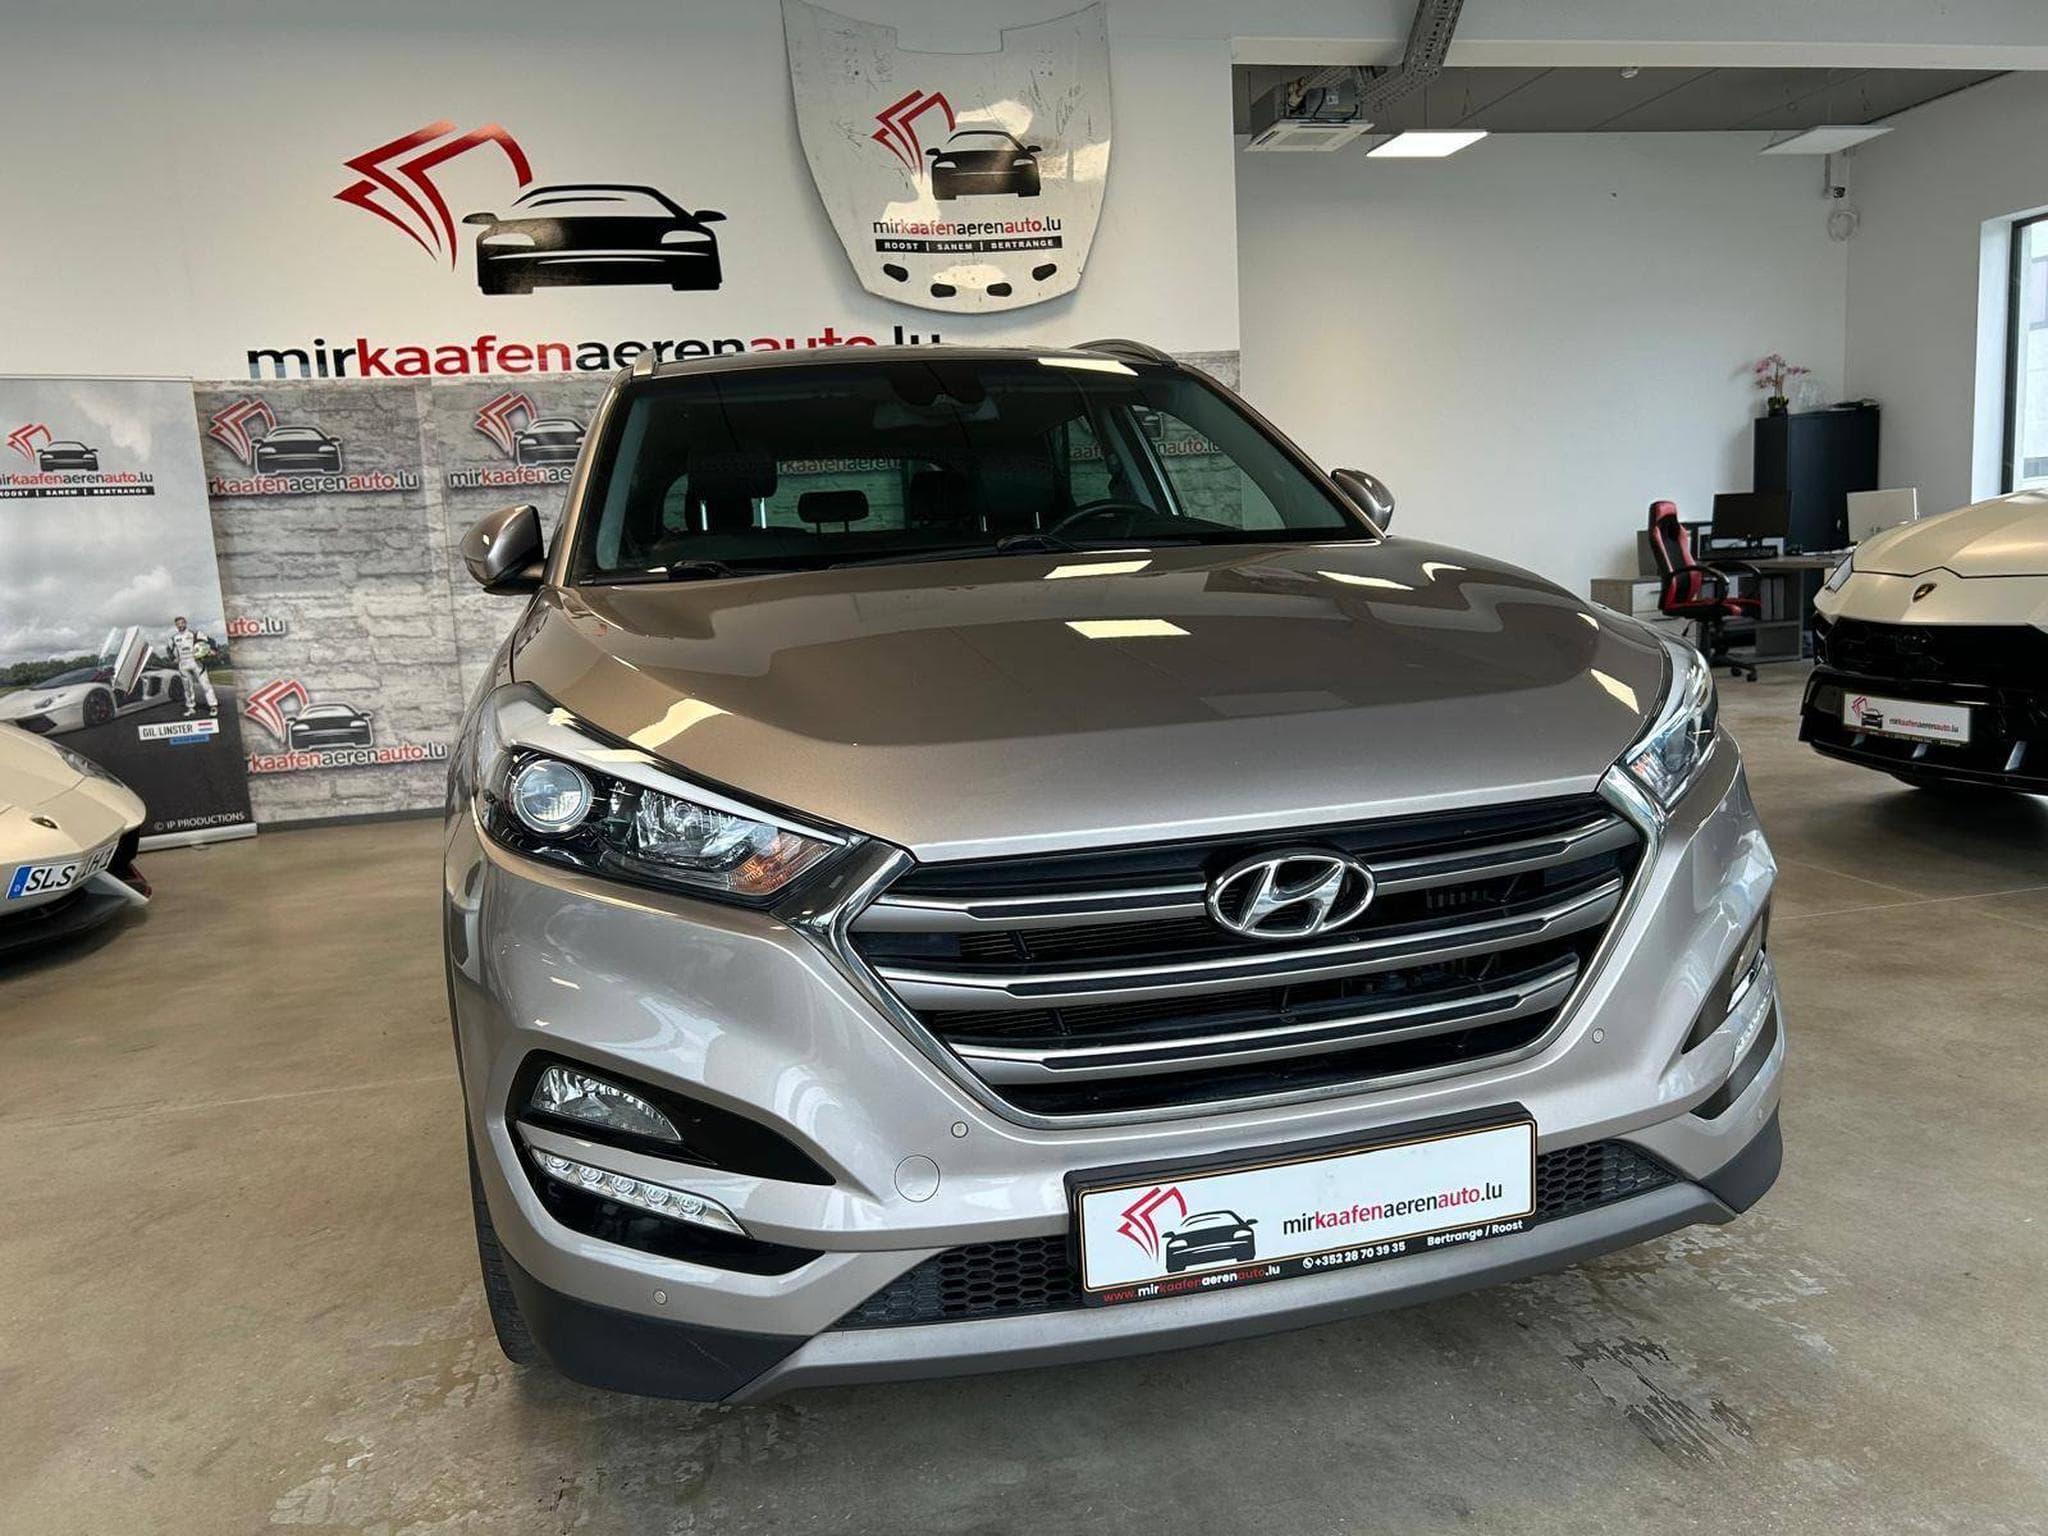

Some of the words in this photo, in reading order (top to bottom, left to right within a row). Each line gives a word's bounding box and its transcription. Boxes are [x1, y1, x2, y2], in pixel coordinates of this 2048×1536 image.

[873, 216, 1062, 237] mirkaafenaerenauto.lu
[884, 241, 919, 250] ROOST
[937, 243, 973, 251] SANEM
[990, 239, 1054, 249] BERTRANGE
[0, 471, 153, 486] irkaafenaerenauto.lu
[143, 727, 156, 738] GIL
[158, 724, 193, 736] LINSTER
[178, 811, 245, 828] PRODUCTIONS
[25, 865, 76, 892] SLS
[1283, 1182, 1503, 1235] mirkaafenaerenauto.lu
[1427, 1226, 1484, 1246] Bertrange
[1492, 1219, 1523, 1235] Roost
[1315, 1253, 1343, 1267] +352
[1345, 1250, 1359, 1263] 28
[1360, 1247, 1374, 1260] 70
[1376, 1244, 1390, 1257] 39
[1391, 1241, 1406, 1254] 35
